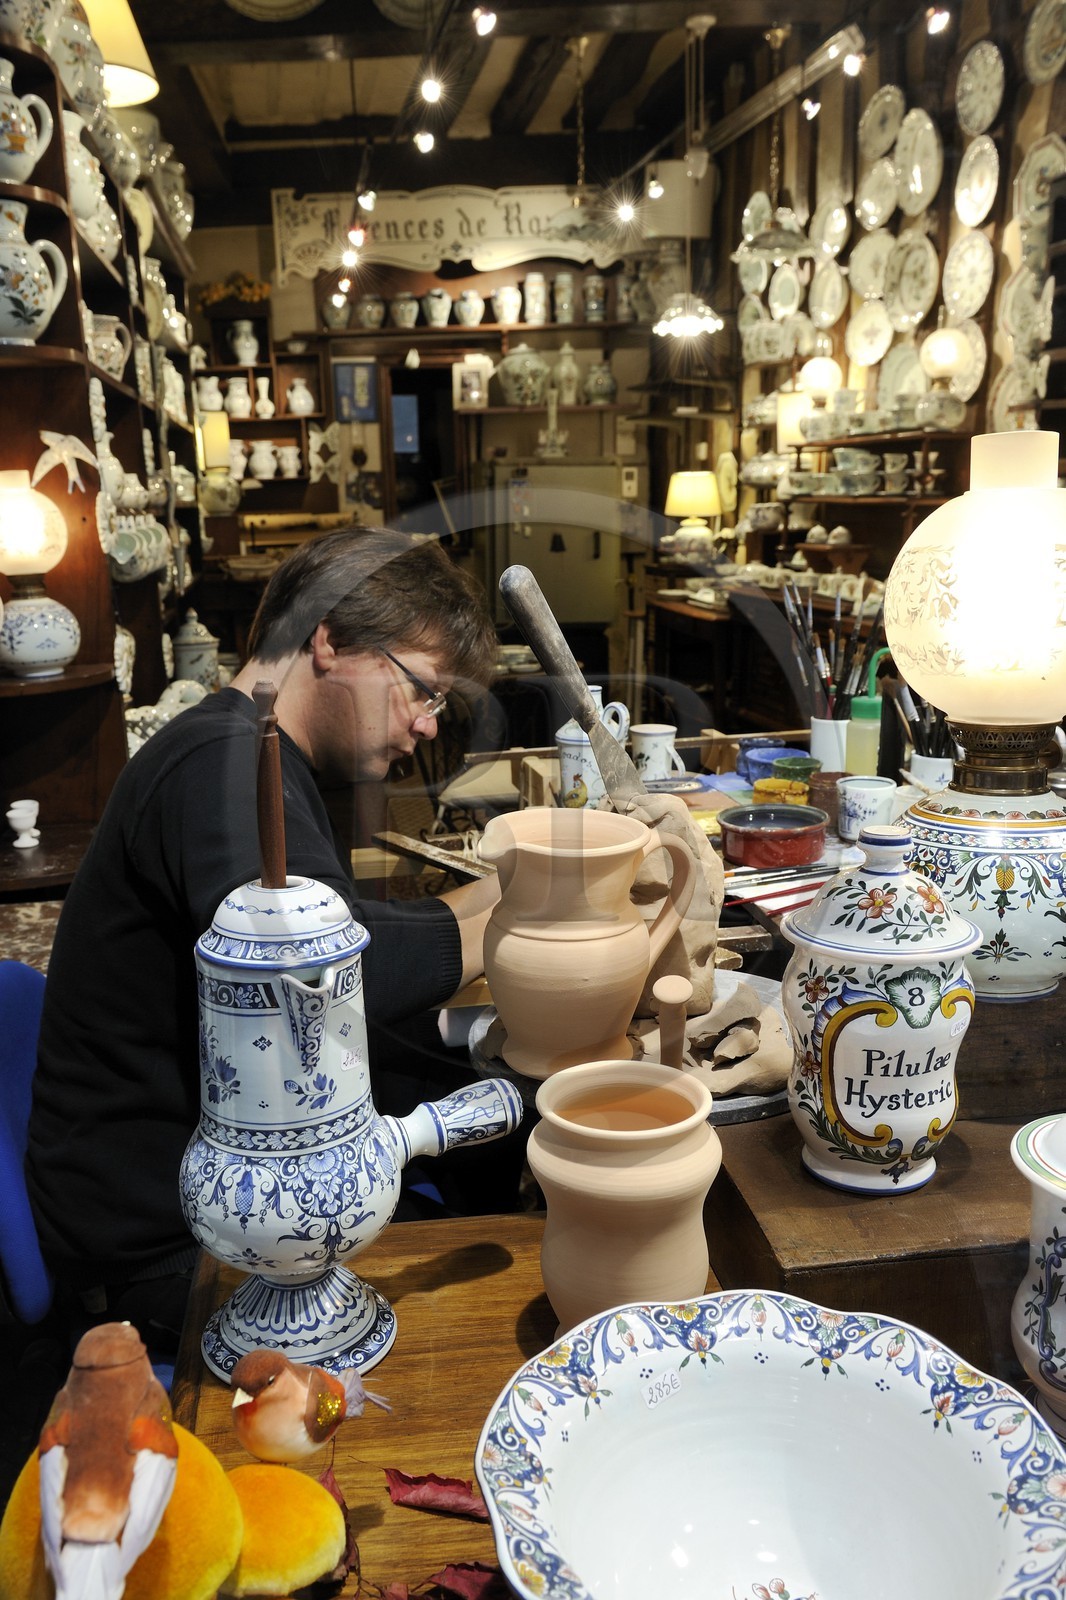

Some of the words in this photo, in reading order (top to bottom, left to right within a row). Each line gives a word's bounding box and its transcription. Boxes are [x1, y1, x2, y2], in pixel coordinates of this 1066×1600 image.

[459, 207, 488, 238] de
[907, 986, 926, 1007] 8
[844, 1077, 953, 1119] Hysteric
